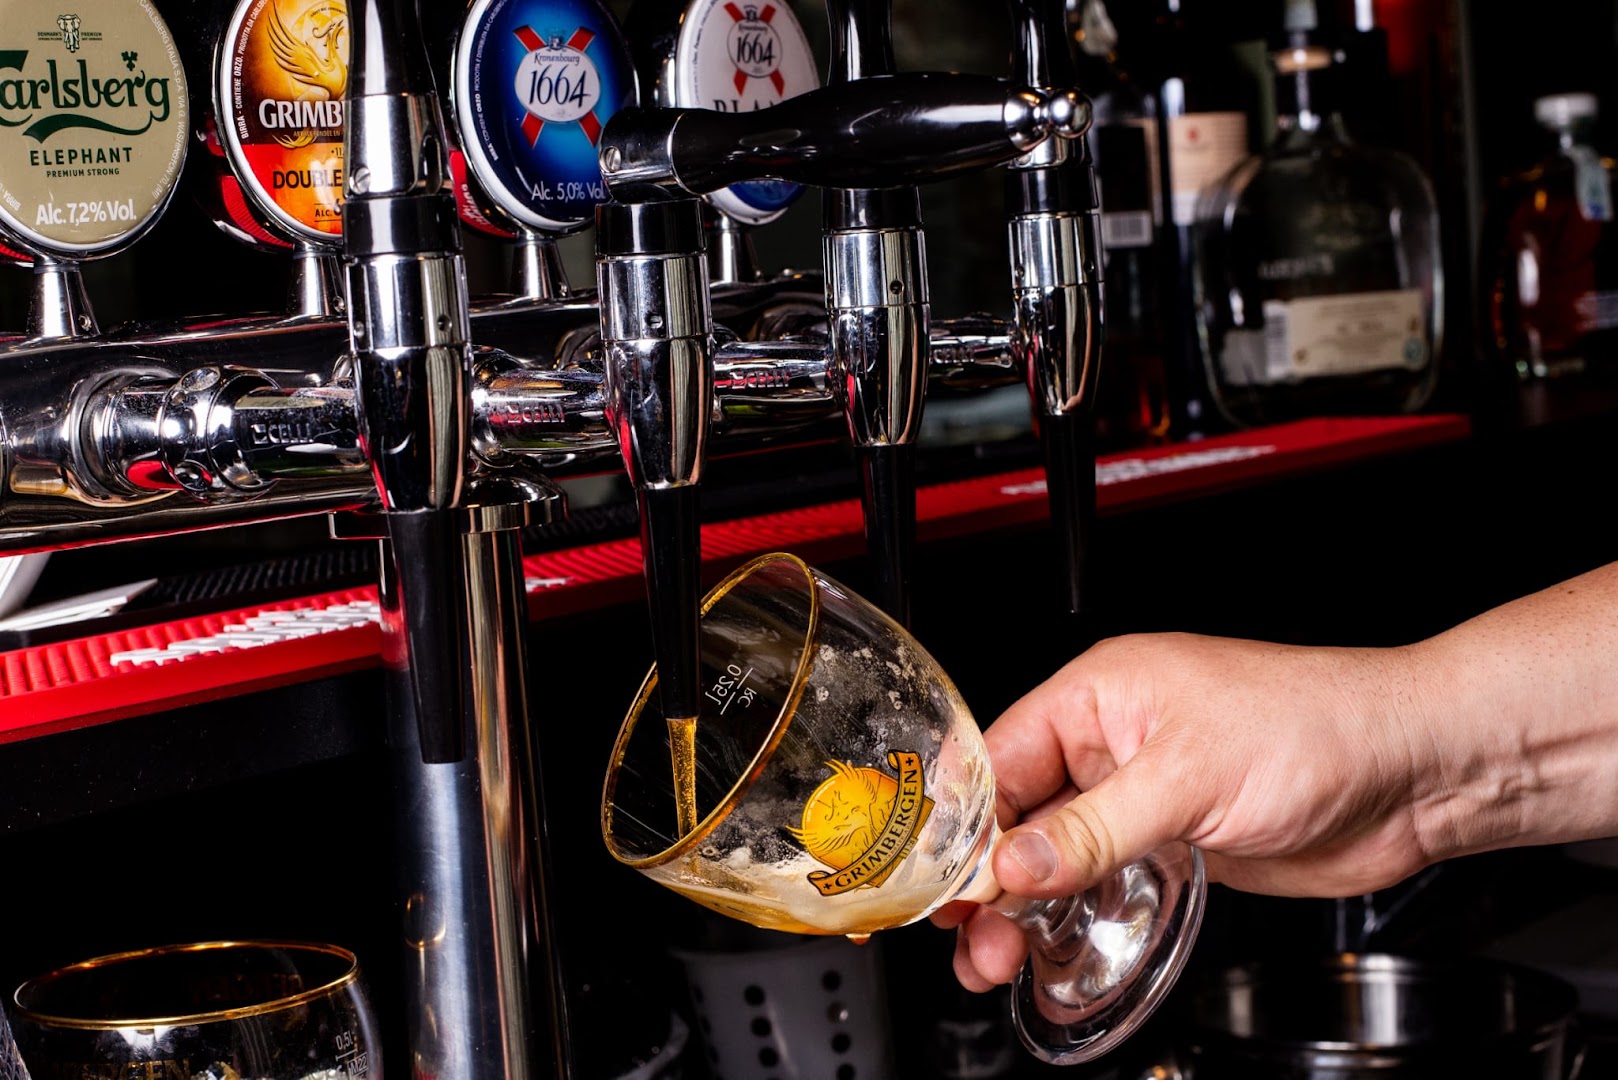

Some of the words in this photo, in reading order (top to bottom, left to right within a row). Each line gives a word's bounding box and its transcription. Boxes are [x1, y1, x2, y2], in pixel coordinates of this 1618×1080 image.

[736, 32, 776, 67] 1664
[234, 78, 243, 109] CONTIENE
[529, 64, 591, 108] 1664
[237, 115, 249, 139] BIRRA
[258, 98, 346, 129] GRIMB
[30, 147, 133, 167] ELEPHANT
[46, 169, 85, 178] PREMIUM
[87, 168, 120, 177] STRONG
[531, 181, 554, 201] Alc.
[556, 181, 586, 204] 5,0%
[35, 202, 67, 226] Alc.
[66, 201, 107, 227] 7,2%
[106, 199, 137, 222] Vol.
[834, 769, 918, 888] GRIMBERGEN
